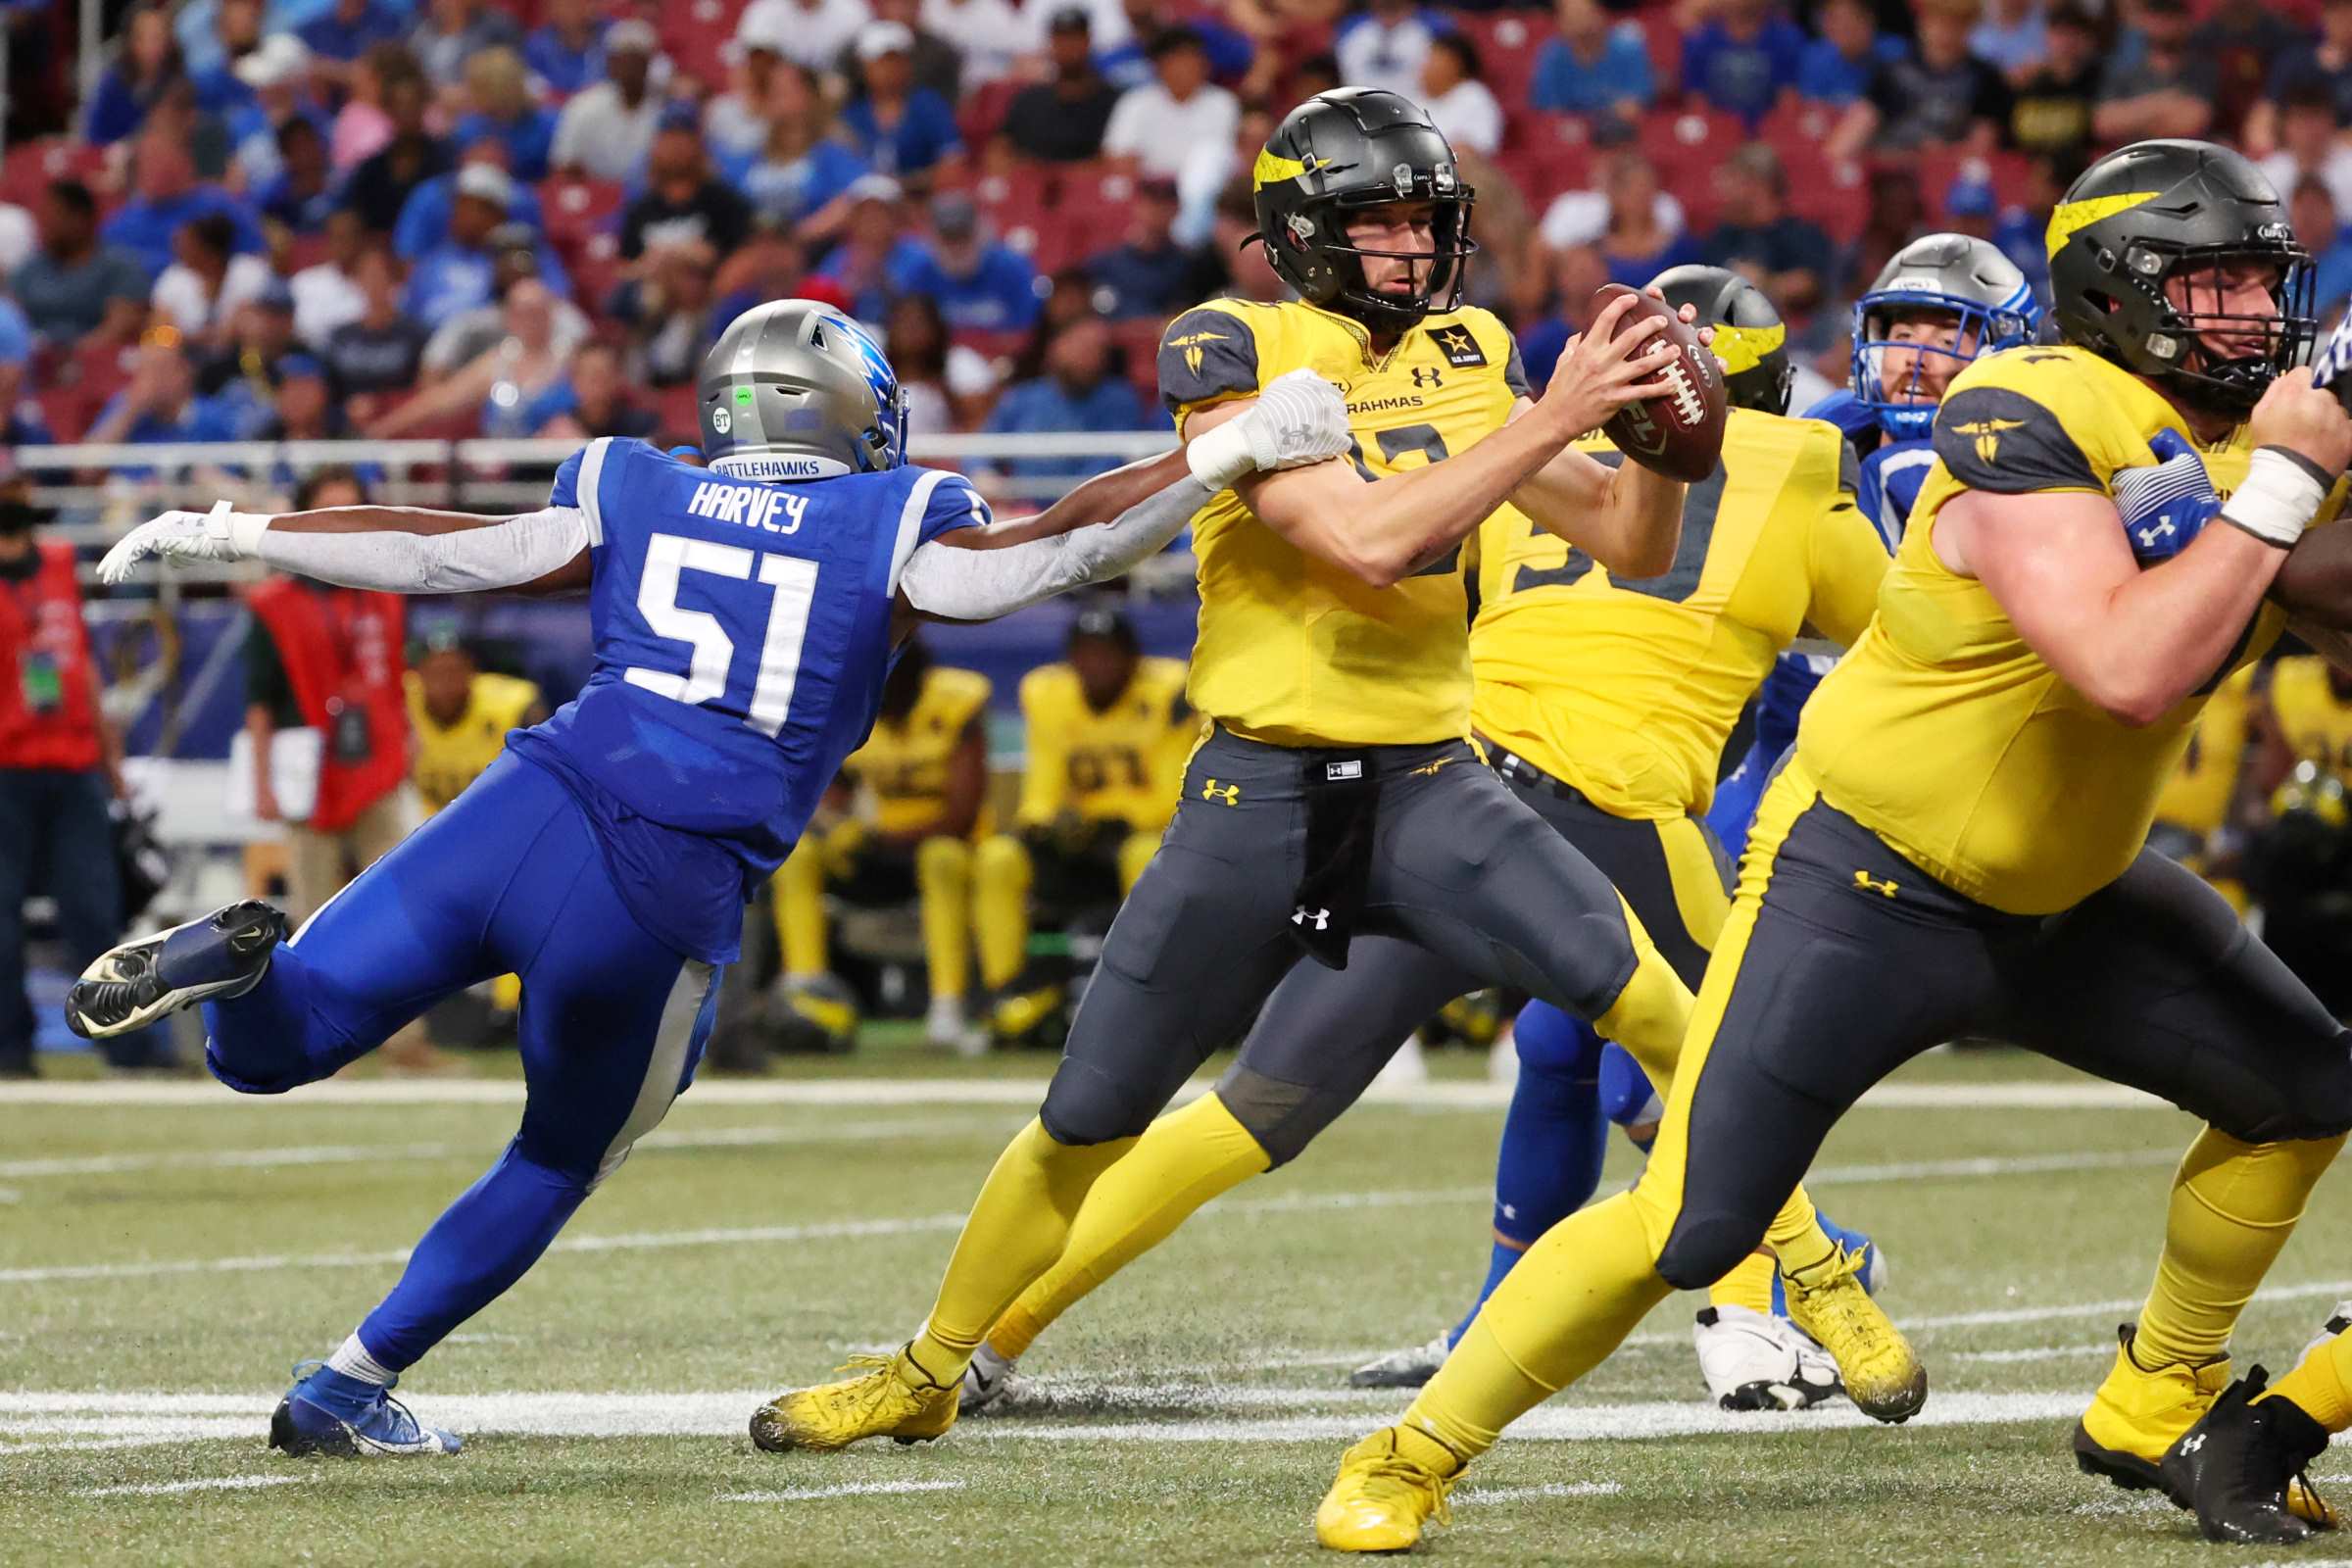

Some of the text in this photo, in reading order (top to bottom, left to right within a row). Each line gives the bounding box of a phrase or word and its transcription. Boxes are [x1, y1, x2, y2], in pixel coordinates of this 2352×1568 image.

[714, 414, 729, 427] BT
[1347, 396, 1424, 415] RAHMAS
[1623, 397, 1657, 441] FL
[687, 481, 809, 534] HARVEY
[623, 532, 820, 739] 51
